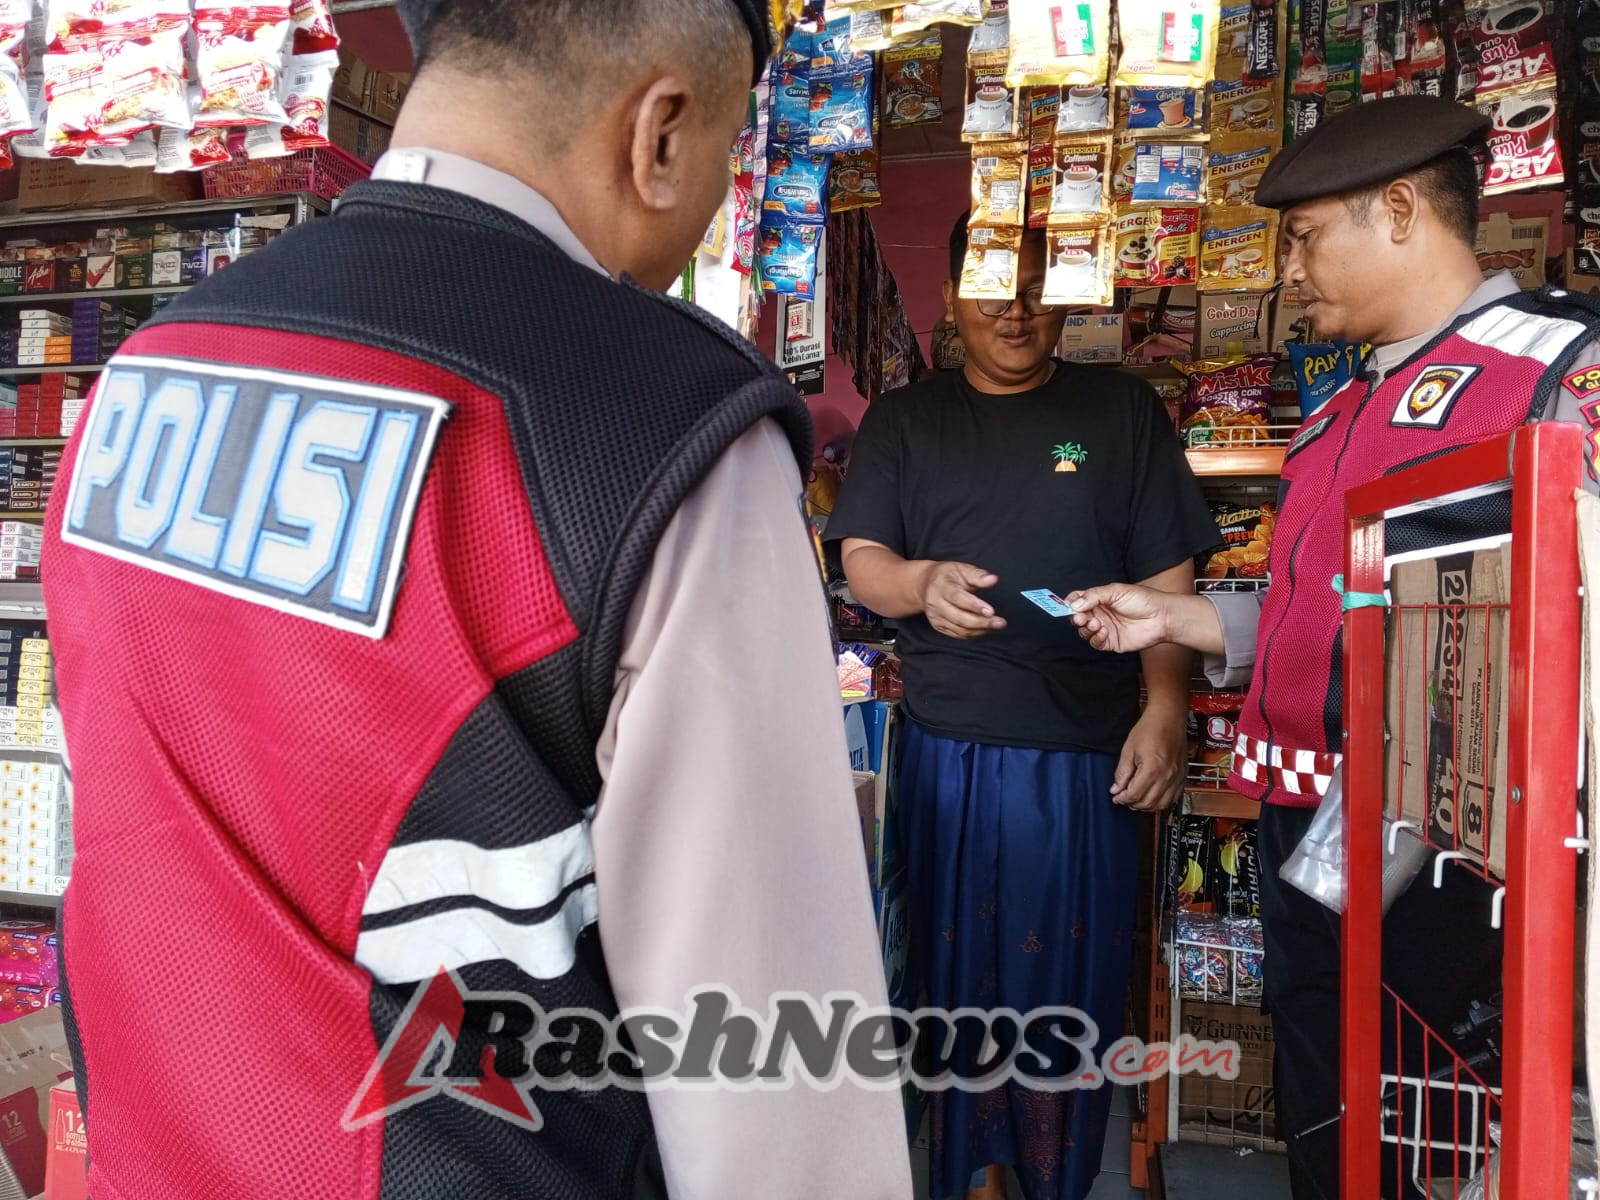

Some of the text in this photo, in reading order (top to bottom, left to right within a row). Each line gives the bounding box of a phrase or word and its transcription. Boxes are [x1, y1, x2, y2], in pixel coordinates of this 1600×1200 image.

[1476, 37, 1501, 50] GULA
[1482, 38, 1519, 63] Plus
[1480, 53, 1546, 87] ABC
[1486, 134, 1511, 147] GULA
[1491, 137, 1528, 161] Plus
[1211, 156, 1265, 176] ENERGEN
[1489, 150, 1556, 184] ABC
[1207, 231, 1262, 250] ENERGEN
[1066, 316, 1119, 327] INDILK
[1206, 306, 1238, 320] Good
[1210, 320, 1257, 338] Cappuccino
[1241, 388, 1262, 397] CORN
[69, 371, 421, 614] POLISI
[1435, 758, 1456, 835] 40
[1467, 801, 1483, 834] 8
[1, 1110, 22, 1129] 12
[65, 1110, 86, 1133] 12
